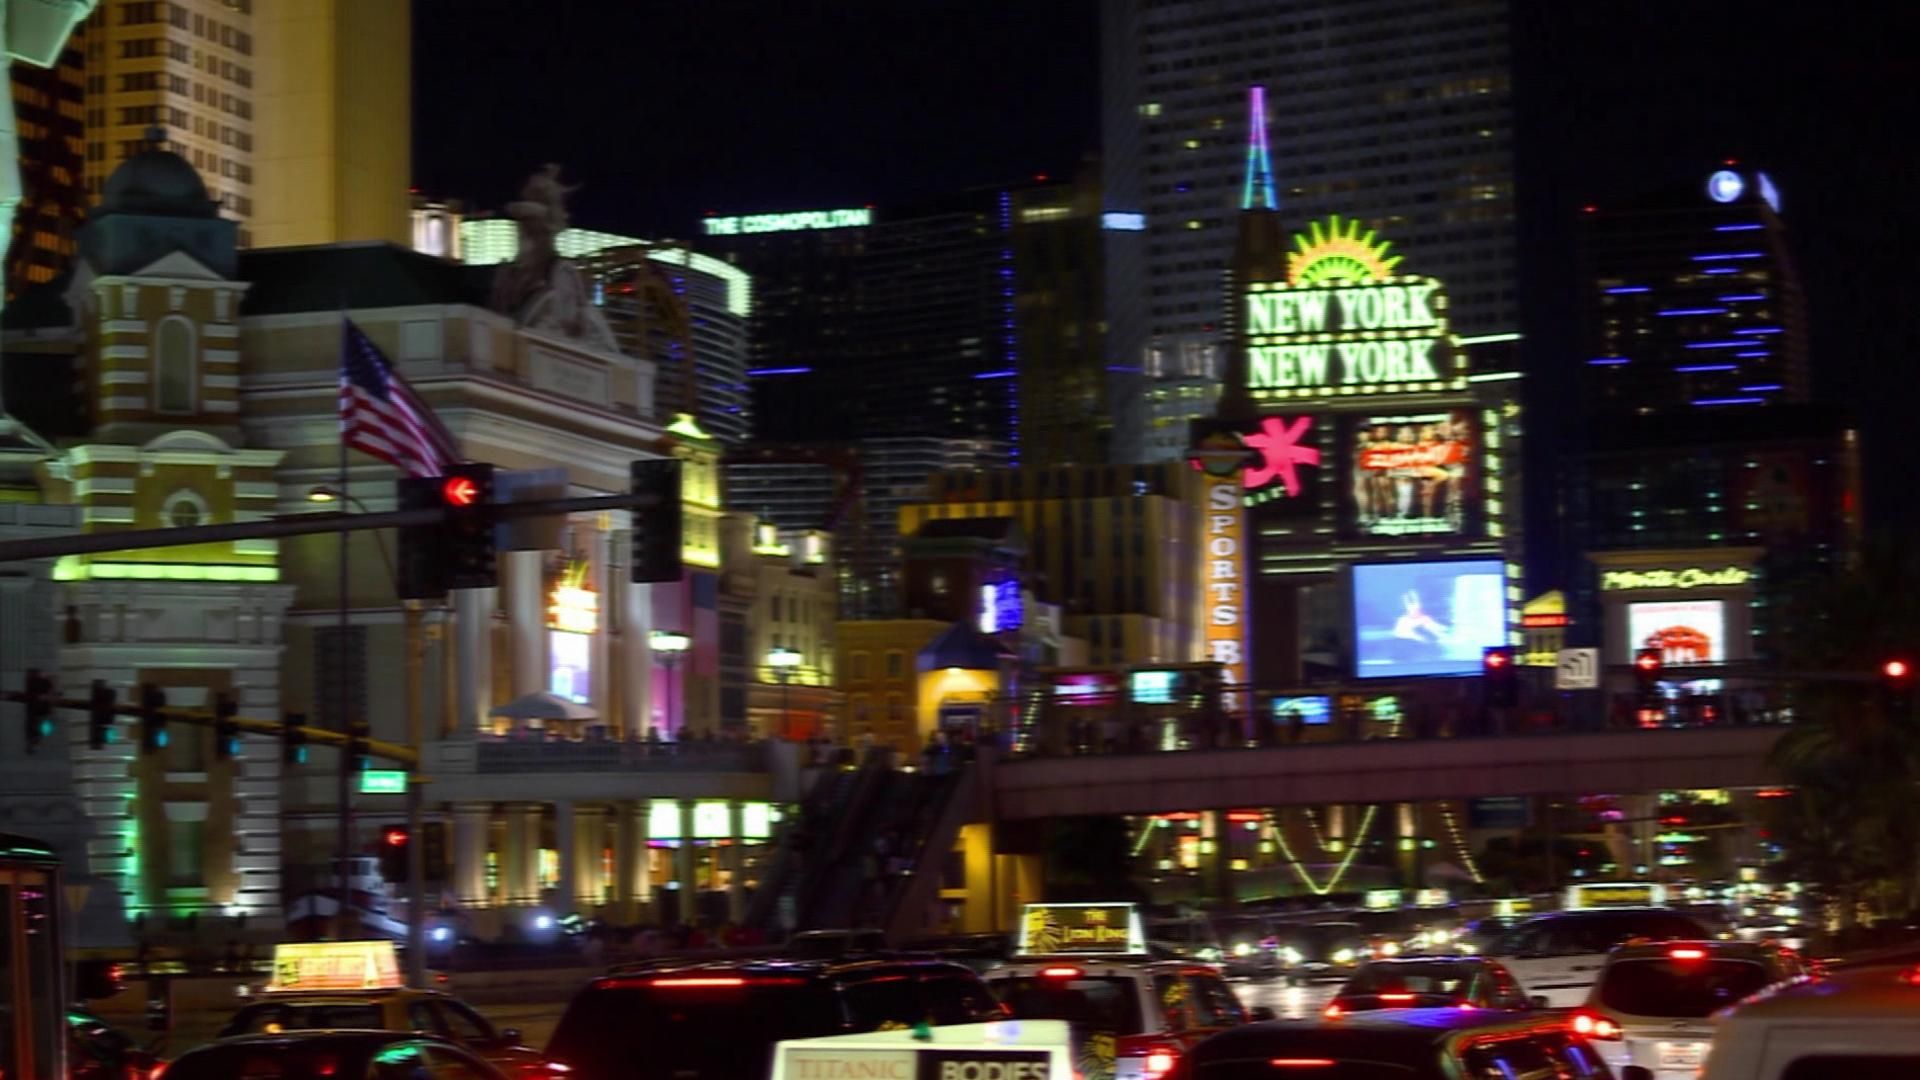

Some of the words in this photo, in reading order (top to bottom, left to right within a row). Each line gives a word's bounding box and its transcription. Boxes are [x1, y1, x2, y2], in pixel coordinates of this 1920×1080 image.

[704, 217, 738, 234] THE
[743, 209, 871, 233] COSMOPOLITAN
[1247, 290, 1329, 334] NEW
[1336, 285, 1437, 330] YORK
[1247, 344, 1329, 388] NEW
[1336, 339, 1437, 384] YORK
[1210, 484, 1238, 625] SPORTS
[795, 1058, 908, 1080] TITANIC
[942, 1060, 1048, 1080] BODIES
